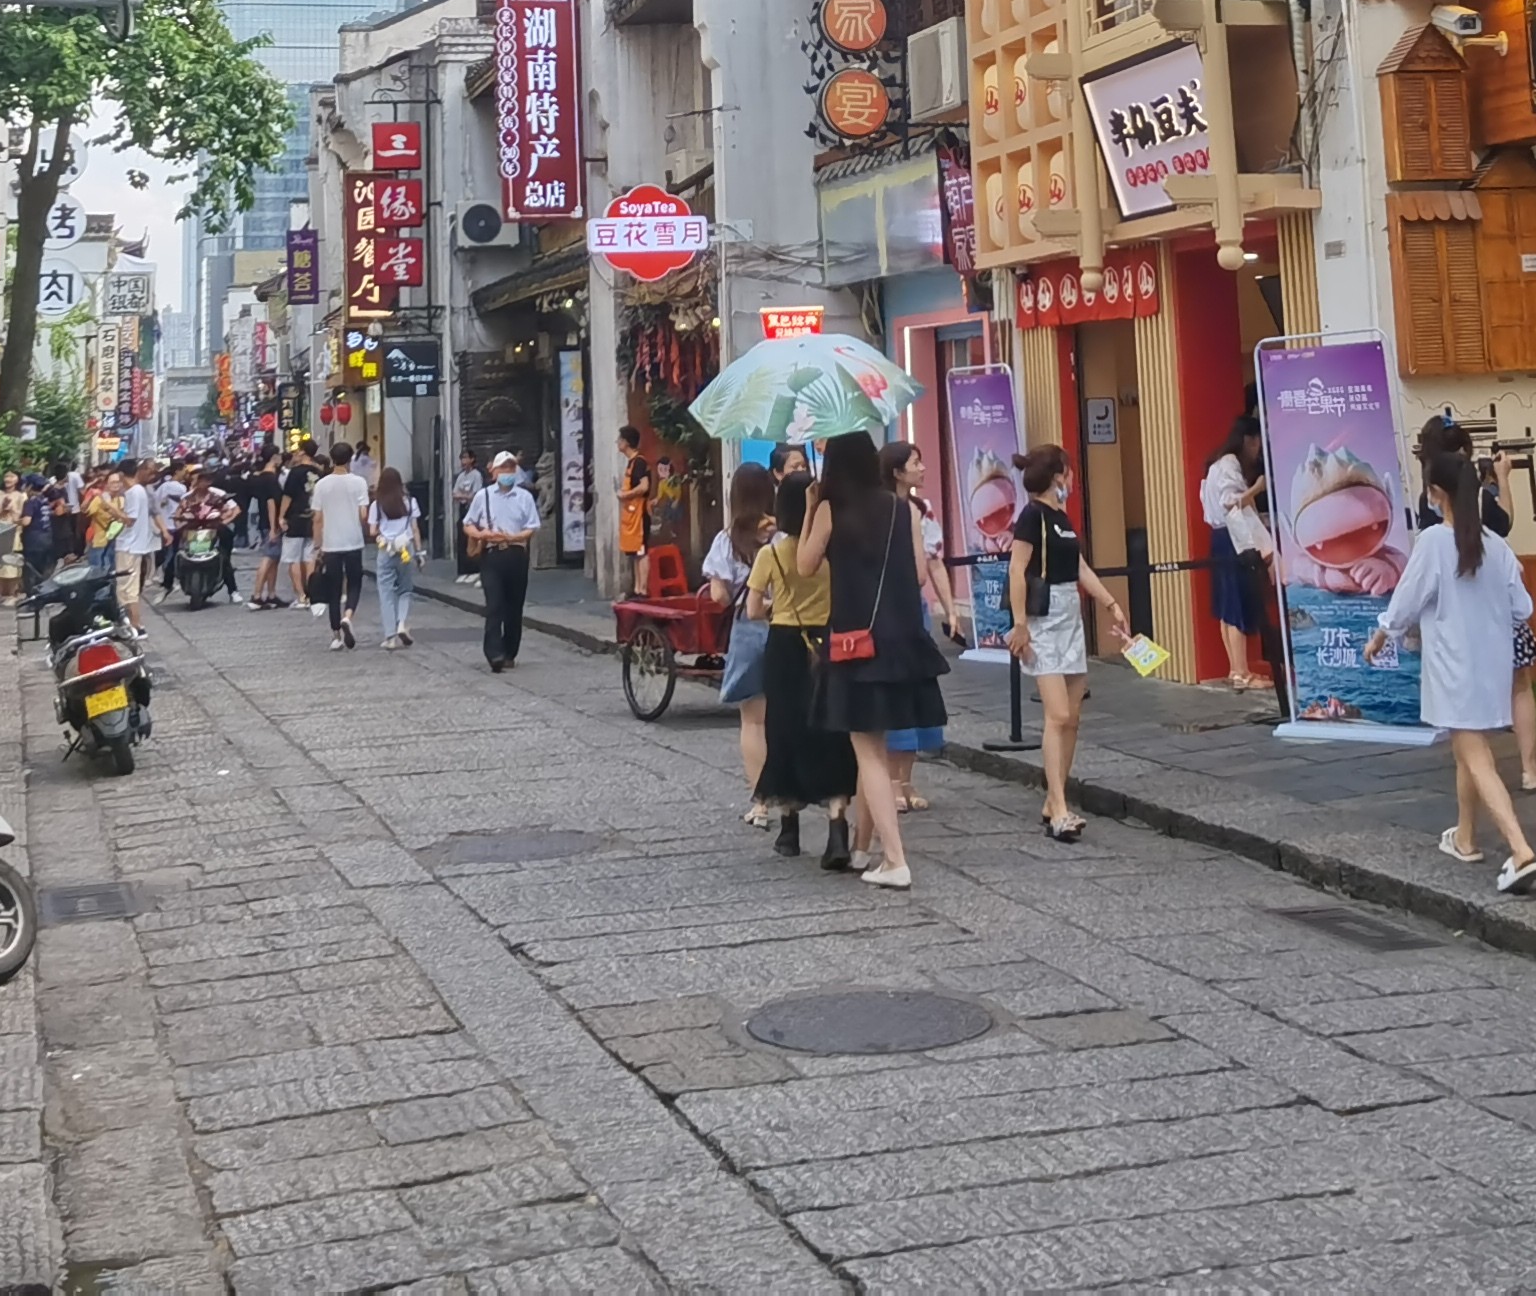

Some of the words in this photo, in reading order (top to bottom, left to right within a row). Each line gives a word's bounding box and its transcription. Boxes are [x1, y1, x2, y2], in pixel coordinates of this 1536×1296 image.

[522, 7, 561, 179] 湖南特产
[524, 180, 566, 208] 总店
[619, 200, 677, 216] SoyaTea
[594, 221, 707, 248] 豆花雪月
